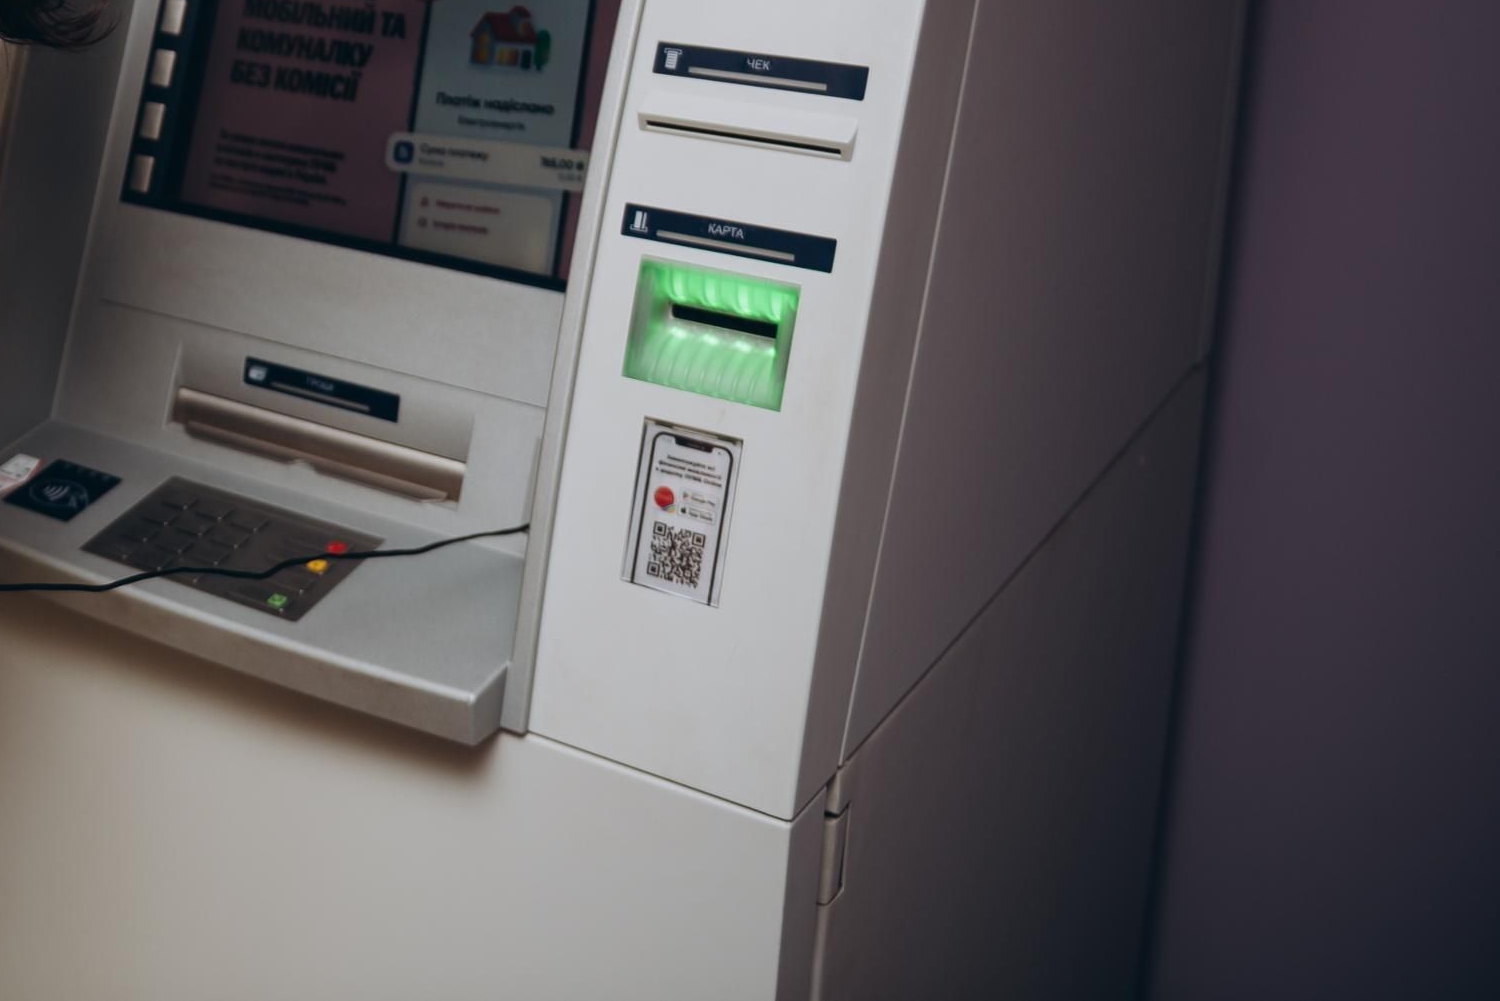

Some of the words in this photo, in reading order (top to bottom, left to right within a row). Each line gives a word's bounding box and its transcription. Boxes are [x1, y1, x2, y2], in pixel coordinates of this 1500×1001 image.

[380, 10, 407, 39] ТА
[236, 27, 373, 67] КОМУНАЛКУ
[229, 59, 272, 88] БЕЗ
[747, 57, 771, 71] ЧЕК
[708, 222, 744, 239] КАРТА
